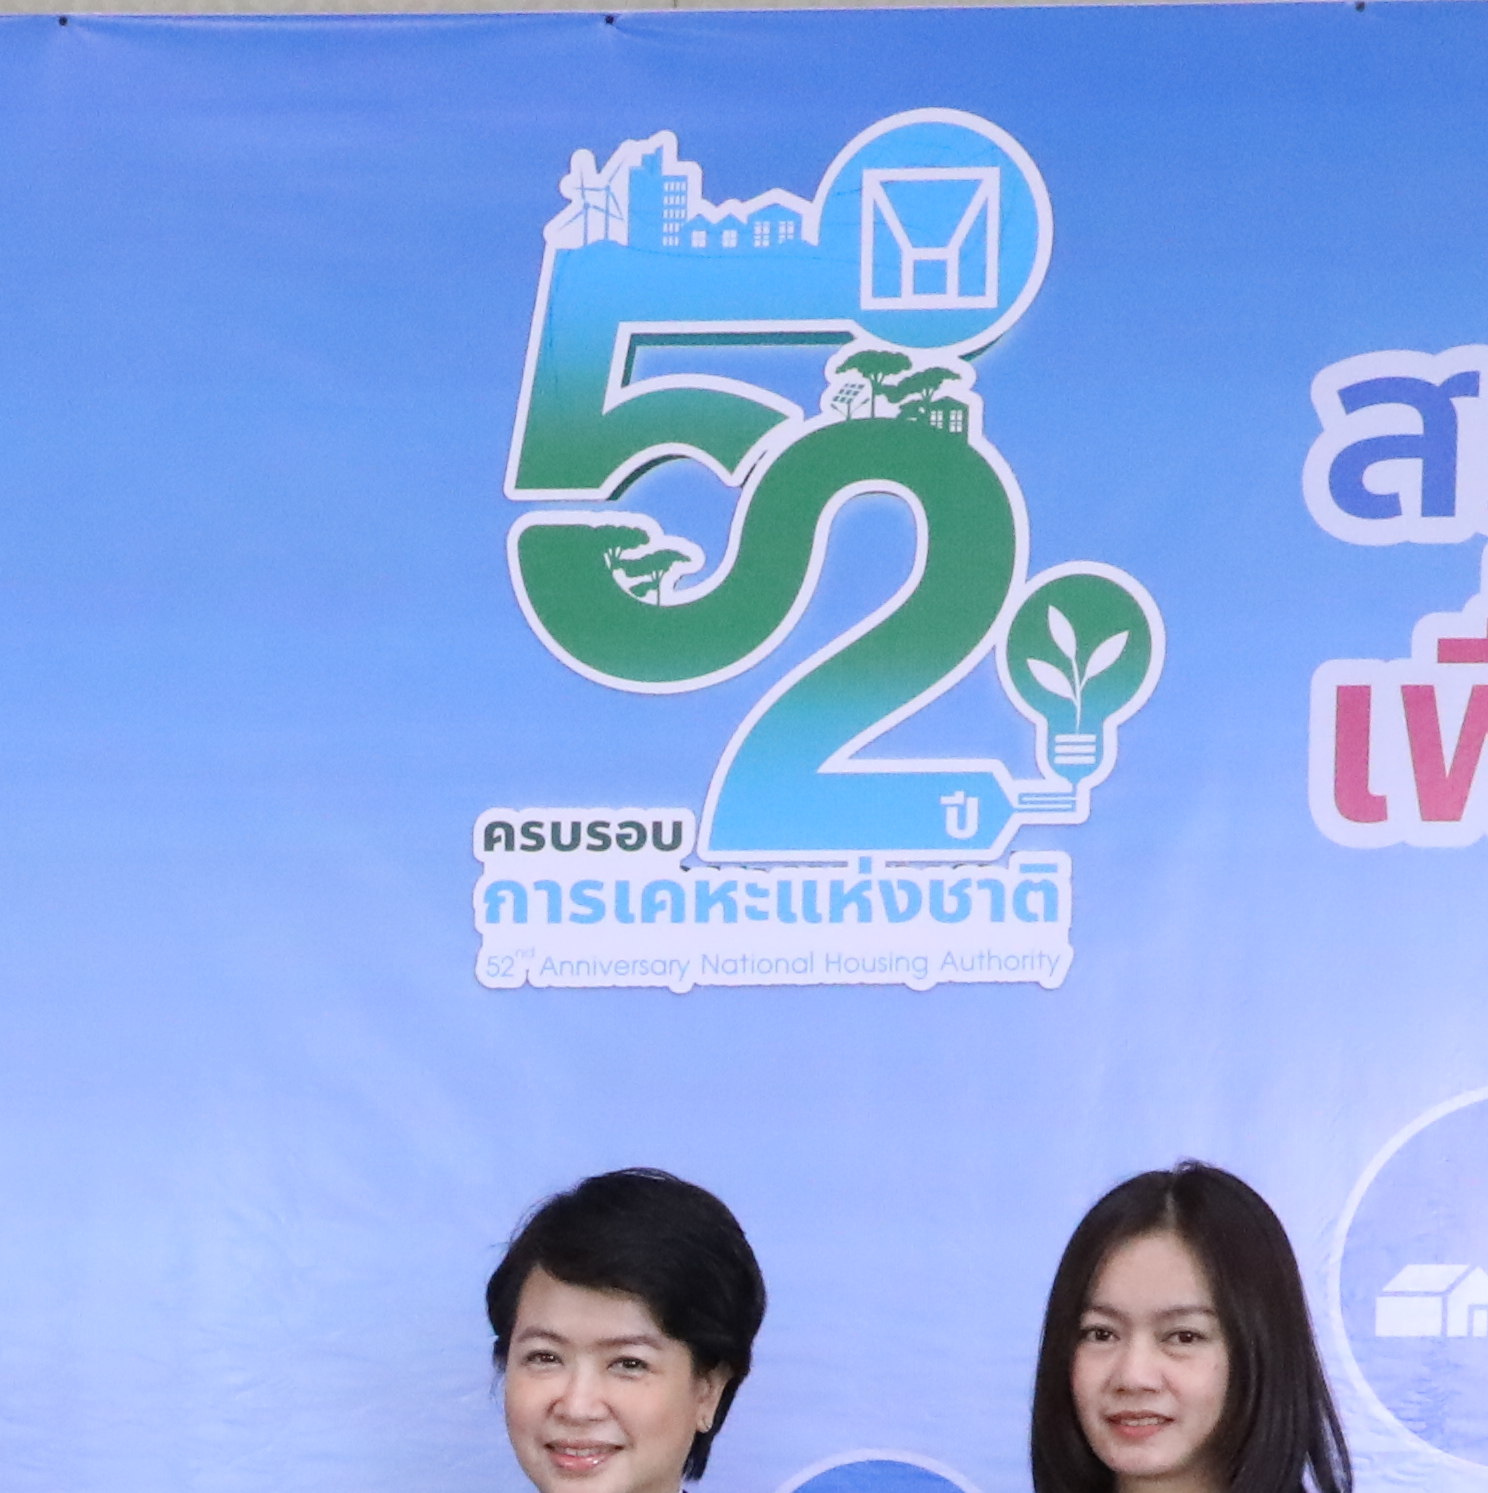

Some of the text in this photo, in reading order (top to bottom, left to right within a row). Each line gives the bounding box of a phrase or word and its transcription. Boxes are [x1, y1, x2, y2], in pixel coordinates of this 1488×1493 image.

[940, 790, 979, 839] ปี
[483, 819, 683, 853] ครบรอบ
[483, 856, 1058, 924] การเคหะแห่งชาติ
[539, 955, 691, 982] Anniversary
[701, 952, 815, 976] National
[825, 950, 929, 980] Housing
[940, 949, 1061, 978] Authority
